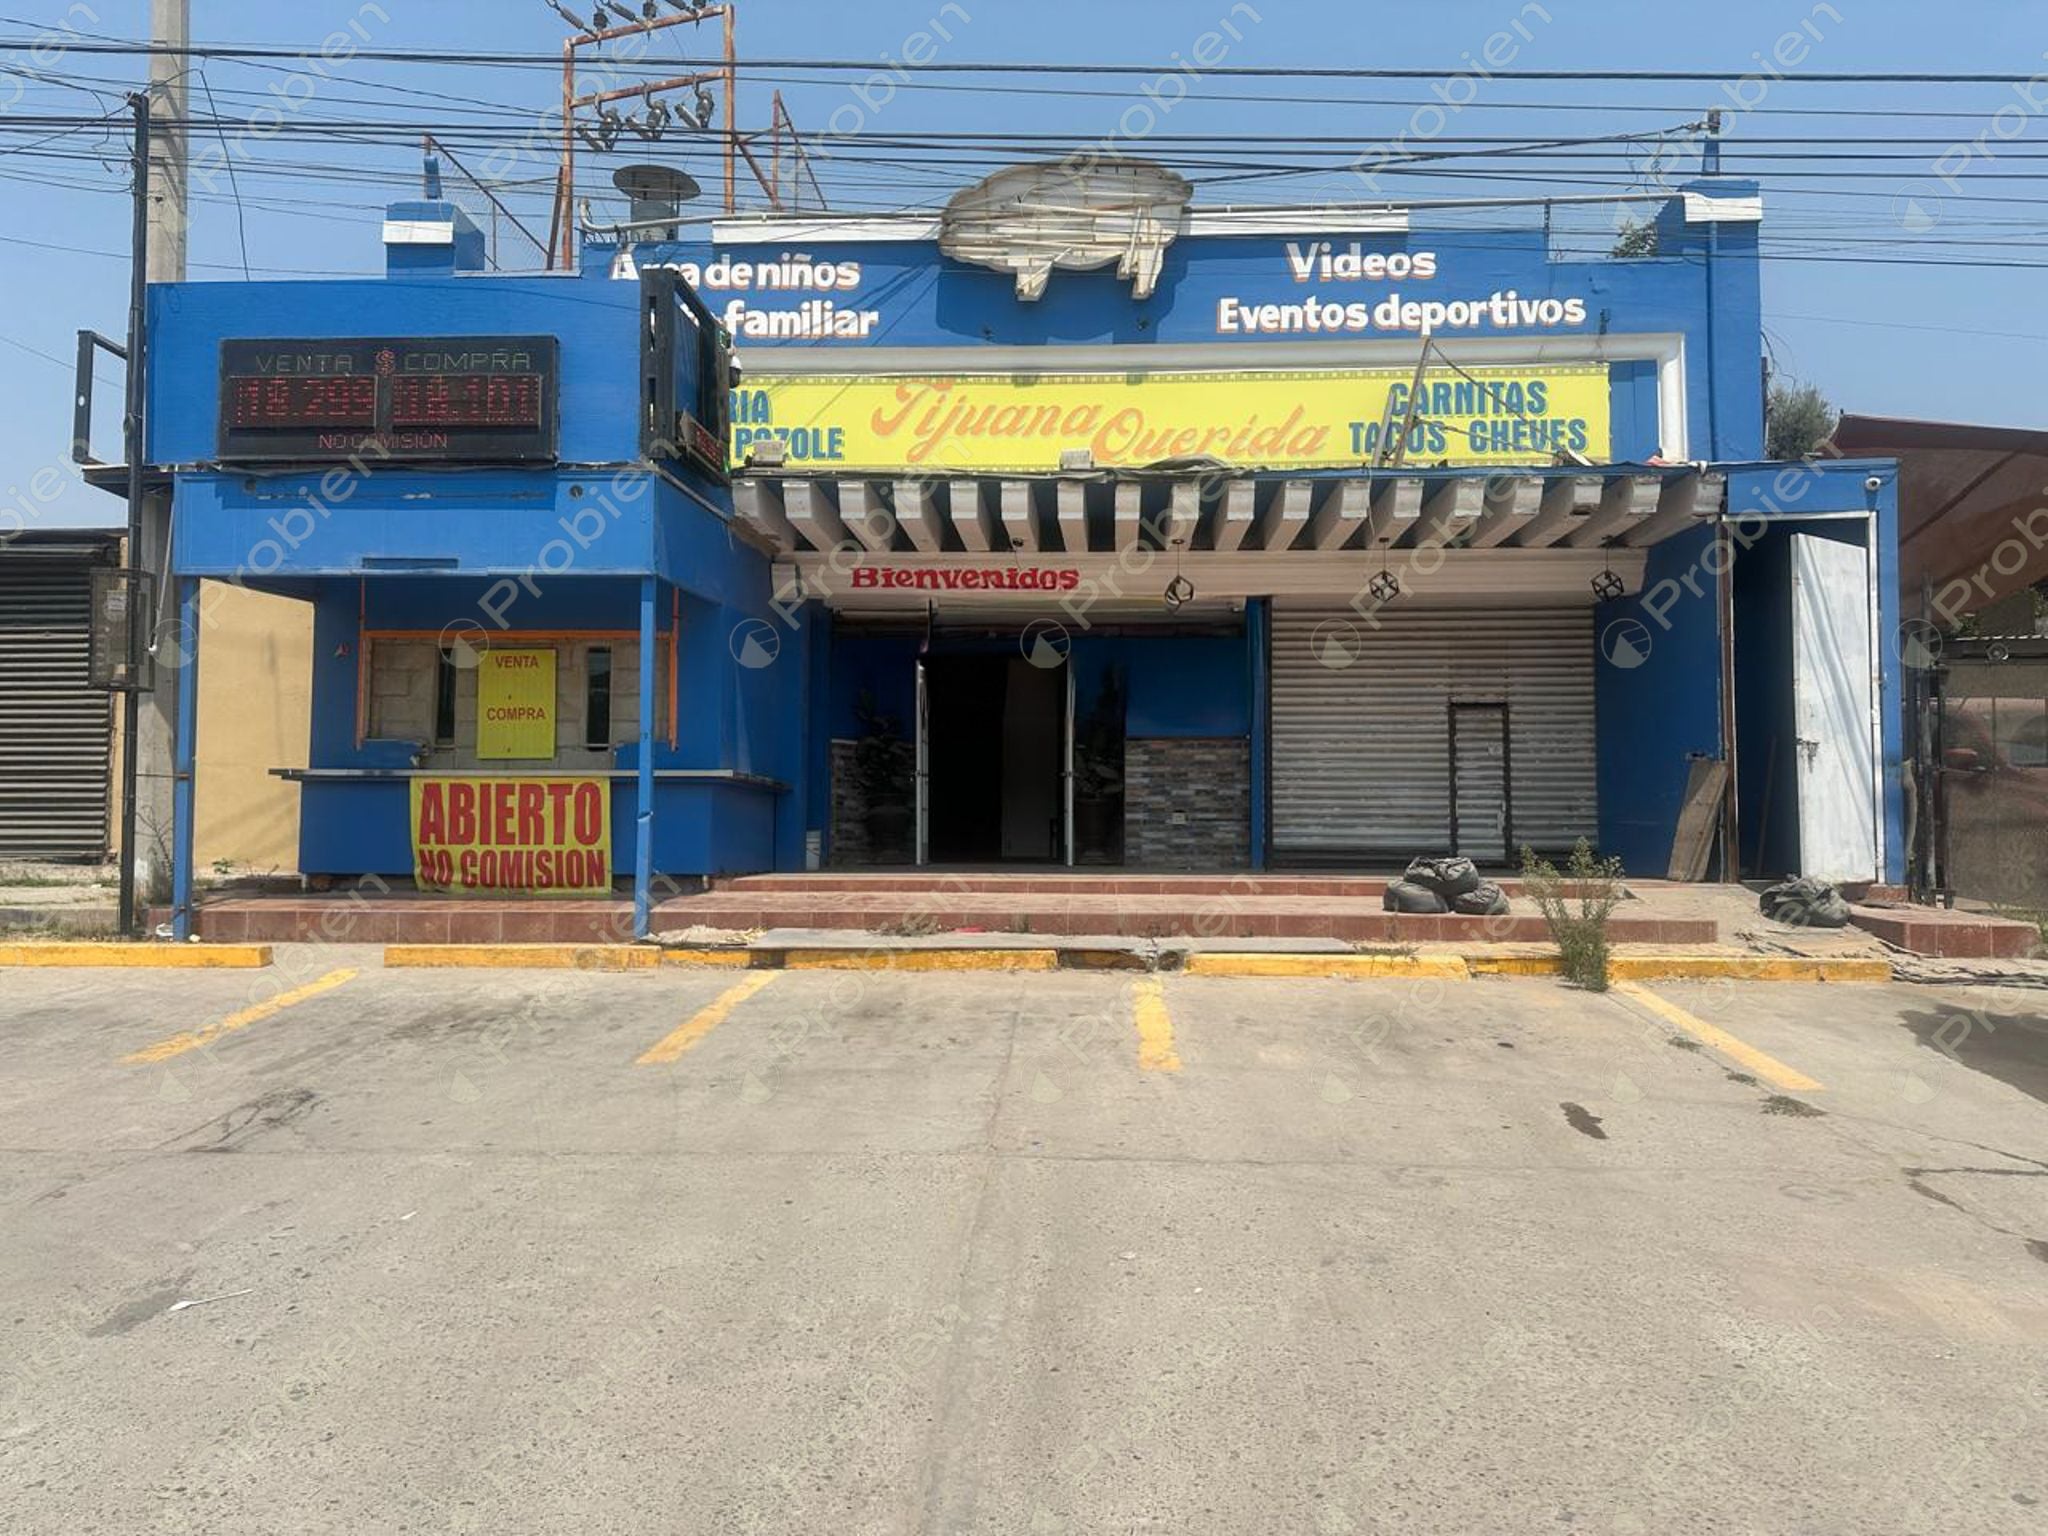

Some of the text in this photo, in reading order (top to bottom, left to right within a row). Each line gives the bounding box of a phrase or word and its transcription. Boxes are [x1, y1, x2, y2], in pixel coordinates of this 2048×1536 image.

[704, 253, 752, 290] de
[756, 252, 862, 290] niños
[1286, 241, 1437, 281] Videos
[724, 299, 880, 339] familiar
[1217, 290, 1587, 336] Eventos deportivos
[255, 354, 353, 372] VENTA
[1389, 380, 1548, 417] CARNITAS
[319, 434, 346, 449] NO
[871, 382, 1331, 463] Tijuana Querida
[851, 567, 1080, 590] Bienvenidos
[495, 655, 540, 669] VENTA
[486, 706, 546, 721] COMPRA
[419, 781, 602, 846] ABIERTO
[419, 848, 606, 889] NO COMISION
